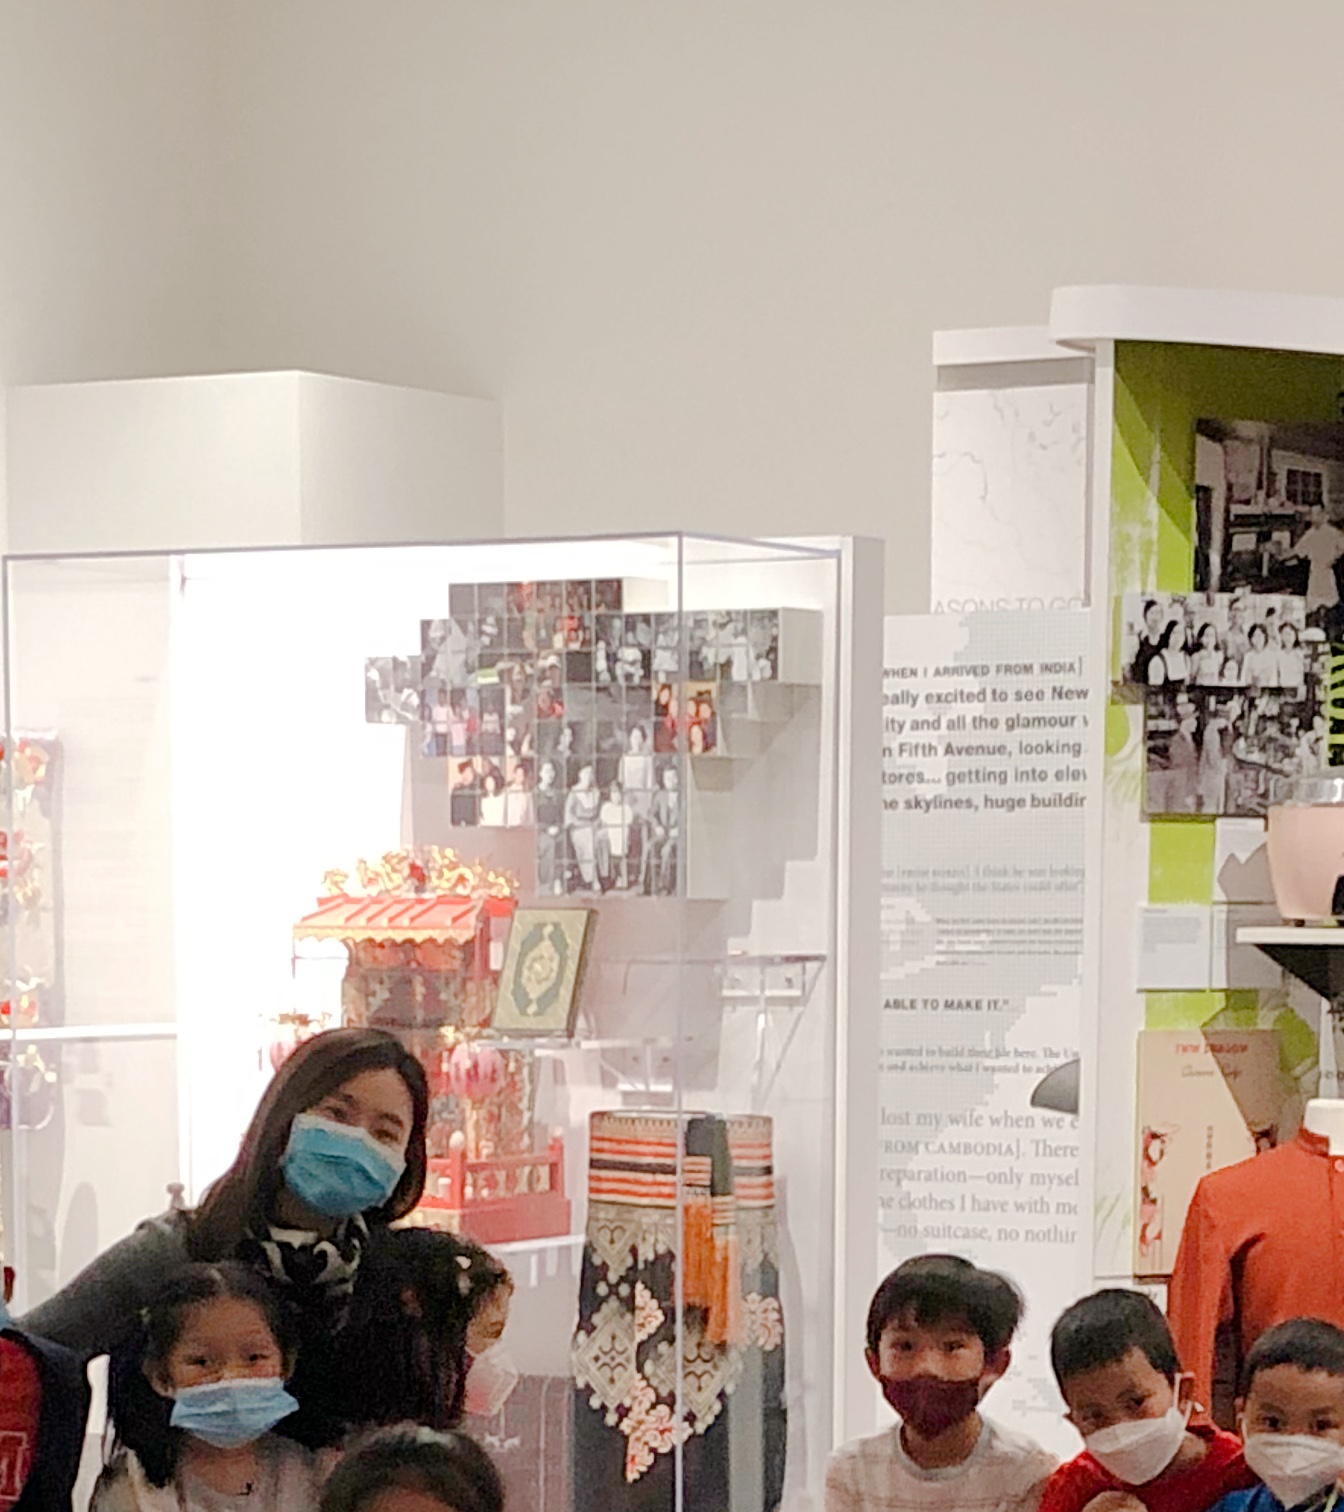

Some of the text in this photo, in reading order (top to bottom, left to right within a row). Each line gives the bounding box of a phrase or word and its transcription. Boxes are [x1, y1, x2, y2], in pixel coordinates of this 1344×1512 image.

[922, 667, 928, 677] I
[933, 664, 990, 677] ARRIVED
[995, 663, 1035, 675] FROM
[924, 687, 987, 704] excited
[992, 688, 1009, 703] to
[1014, 688, 1045, 703] see
[1051, 684, 1089, 702] New
[910, 714, 941, 731] and
[946, 714, 966, 730] all
[972, 713, 999, 730] the
[1006, 711, 1076, 732] glamour
[898, 741, 937, 758] Fifth
[943, 740, 1012, 759] Avenue,
[1018, 738, 1082, 758] looking
[946, 766, 1008, 787] getting
[1014, 766, 1048, 782] into
[903, 792, 979, 813] skylines,
[983, 792, 1027, 812] huge
[883, 998, 917, 1010] ABLE
[921, 998, 940, 1010] TO
[944, 998, 983, 1010] MAKE
[881, 1105, 911, 1126] lost
[916, 1111, 943, 1131] my
[947, 1107, 984, 1128] wife
[989, 1109, 1035, 1129] when
[1040, 1116, 1066, 1130] we
[881, 1140, 920, 1155] ROM
[1031, 1138, 1080, 1159] There
[897, 1191, 955, 1211] clothes
[960, 1193, 966, 1212] I
[970, 1193, 1009, 1213] have
[1013, 1196, 1050, 1215] with
[923, 1222, 993, 1242] suitcase,
[997, 1227, 1020, 1242] no
